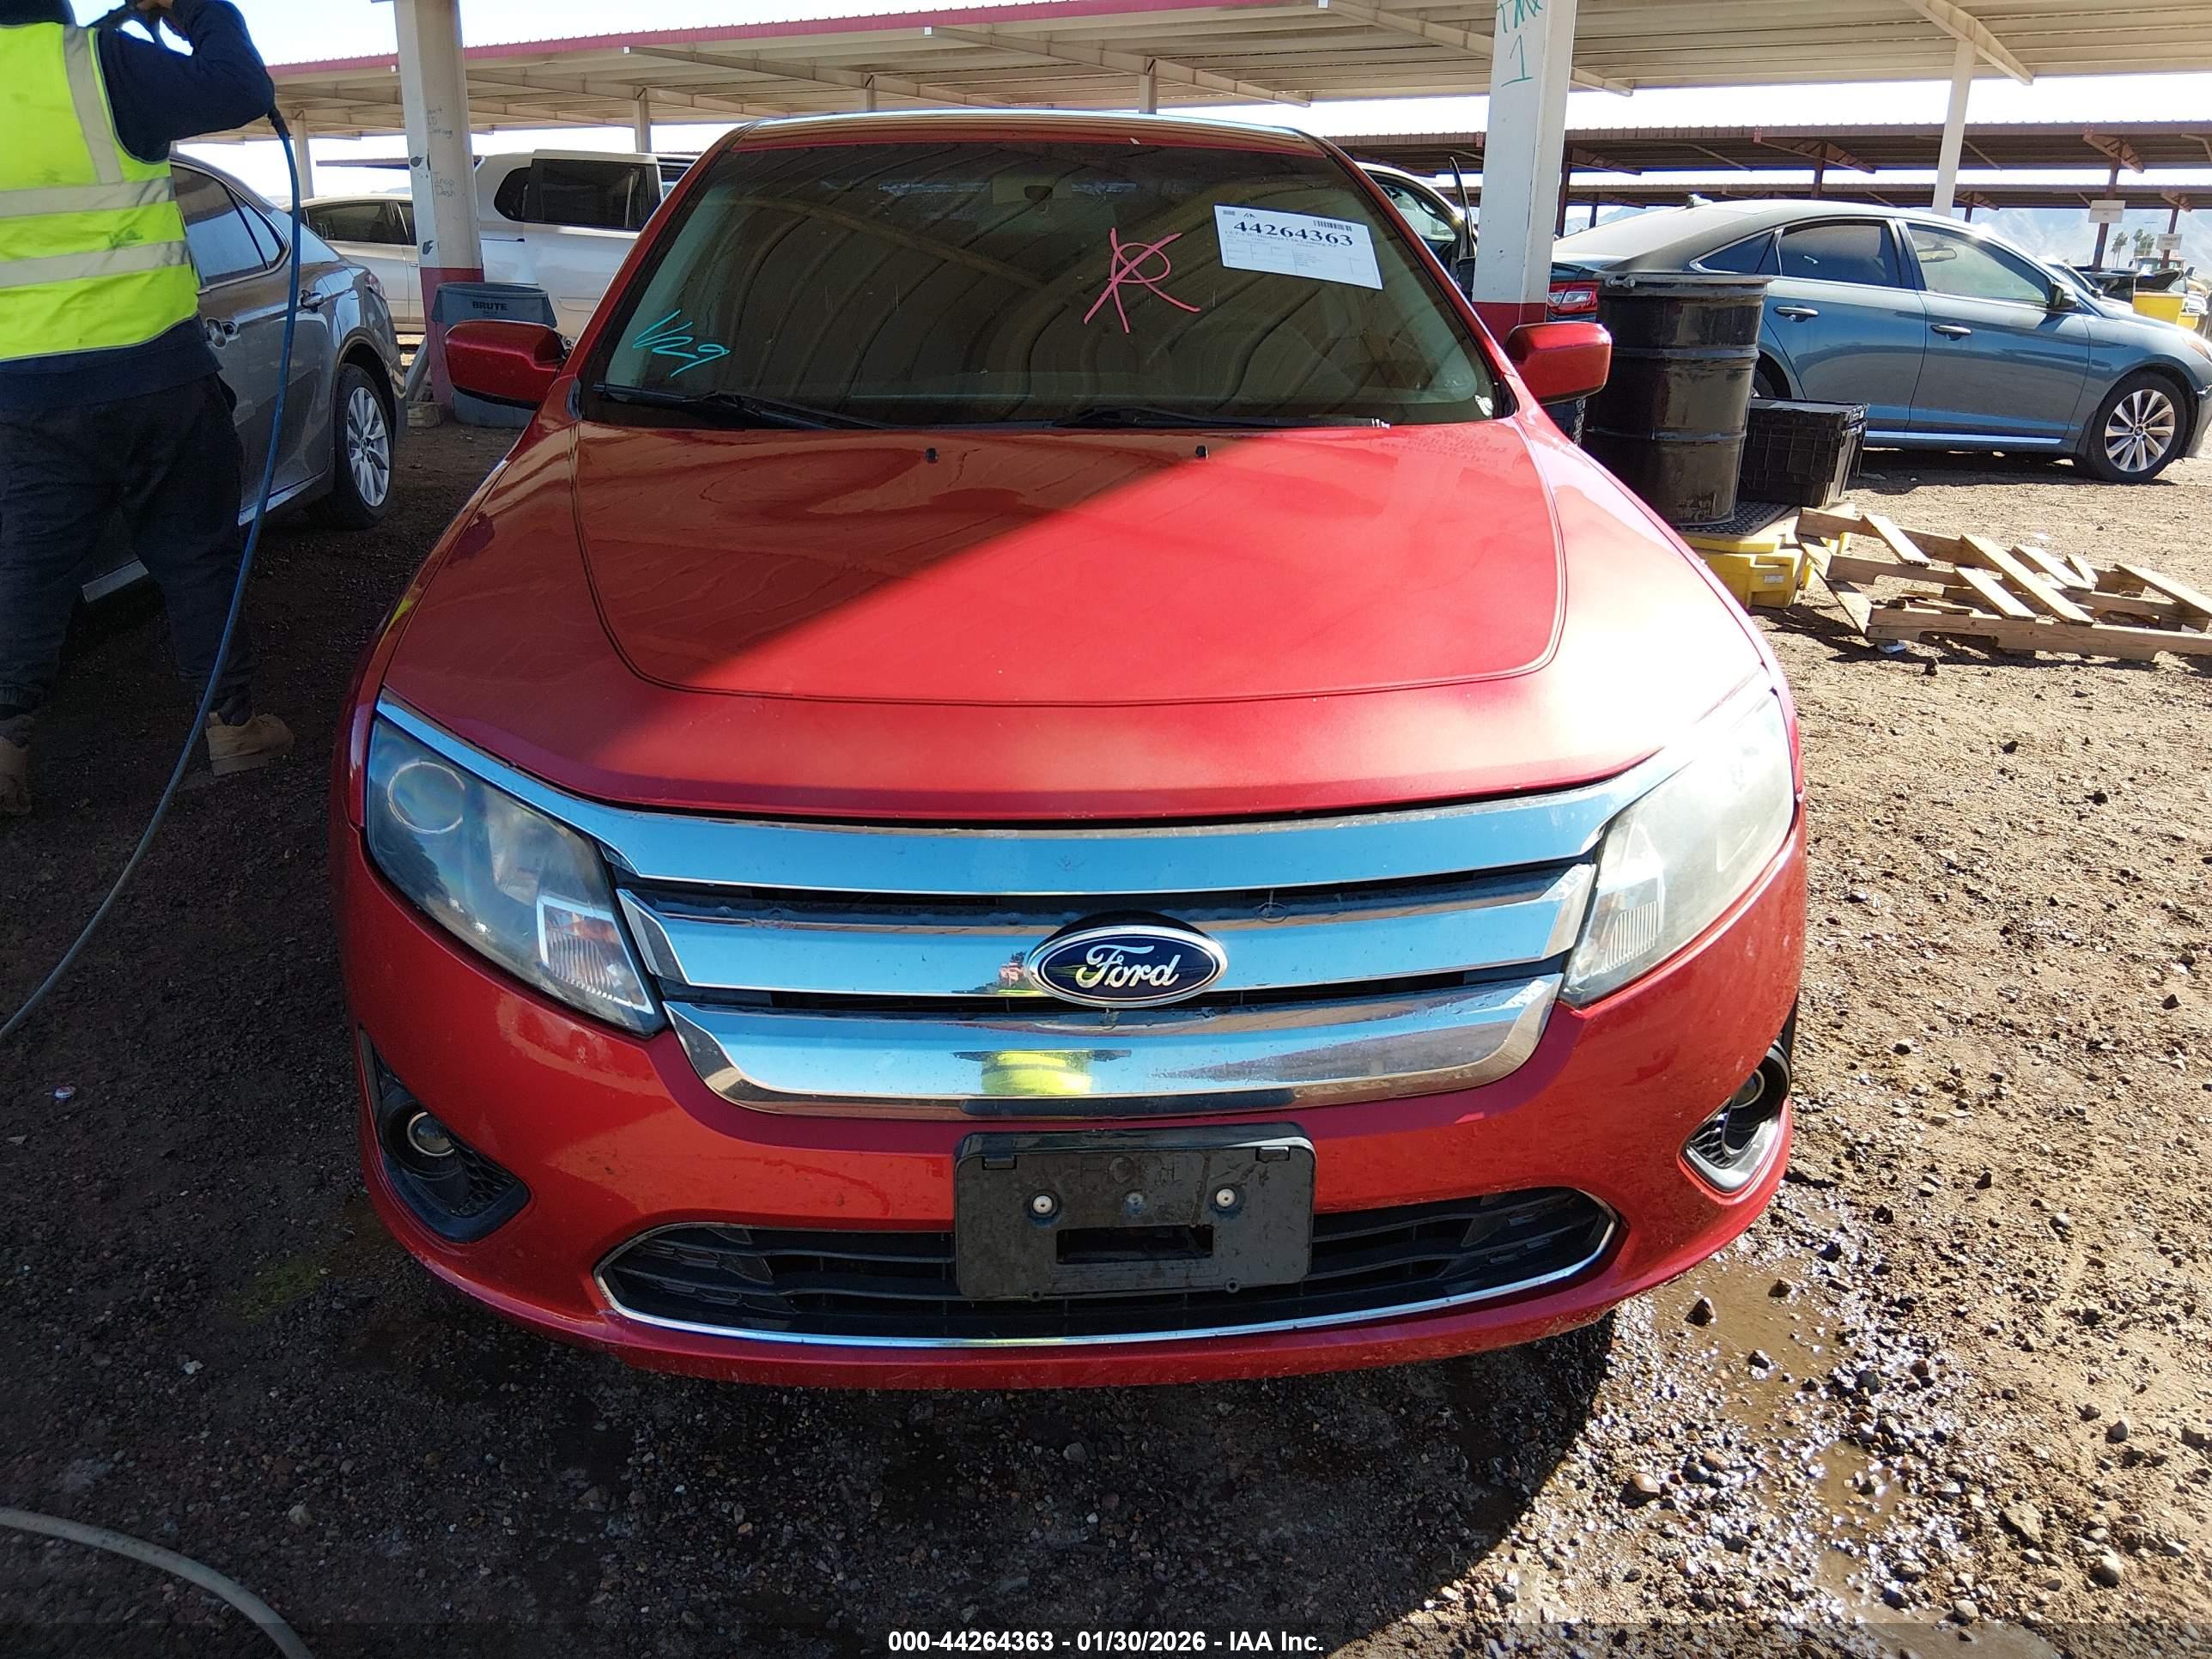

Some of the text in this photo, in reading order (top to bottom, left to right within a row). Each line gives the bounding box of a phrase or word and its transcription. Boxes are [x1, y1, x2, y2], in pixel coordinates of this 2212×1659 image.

[1233, 221, 1354, 247] 44264363
[472, 301, 508, 311] BRUTE
[1075, 944, 1182, 988] Ford
